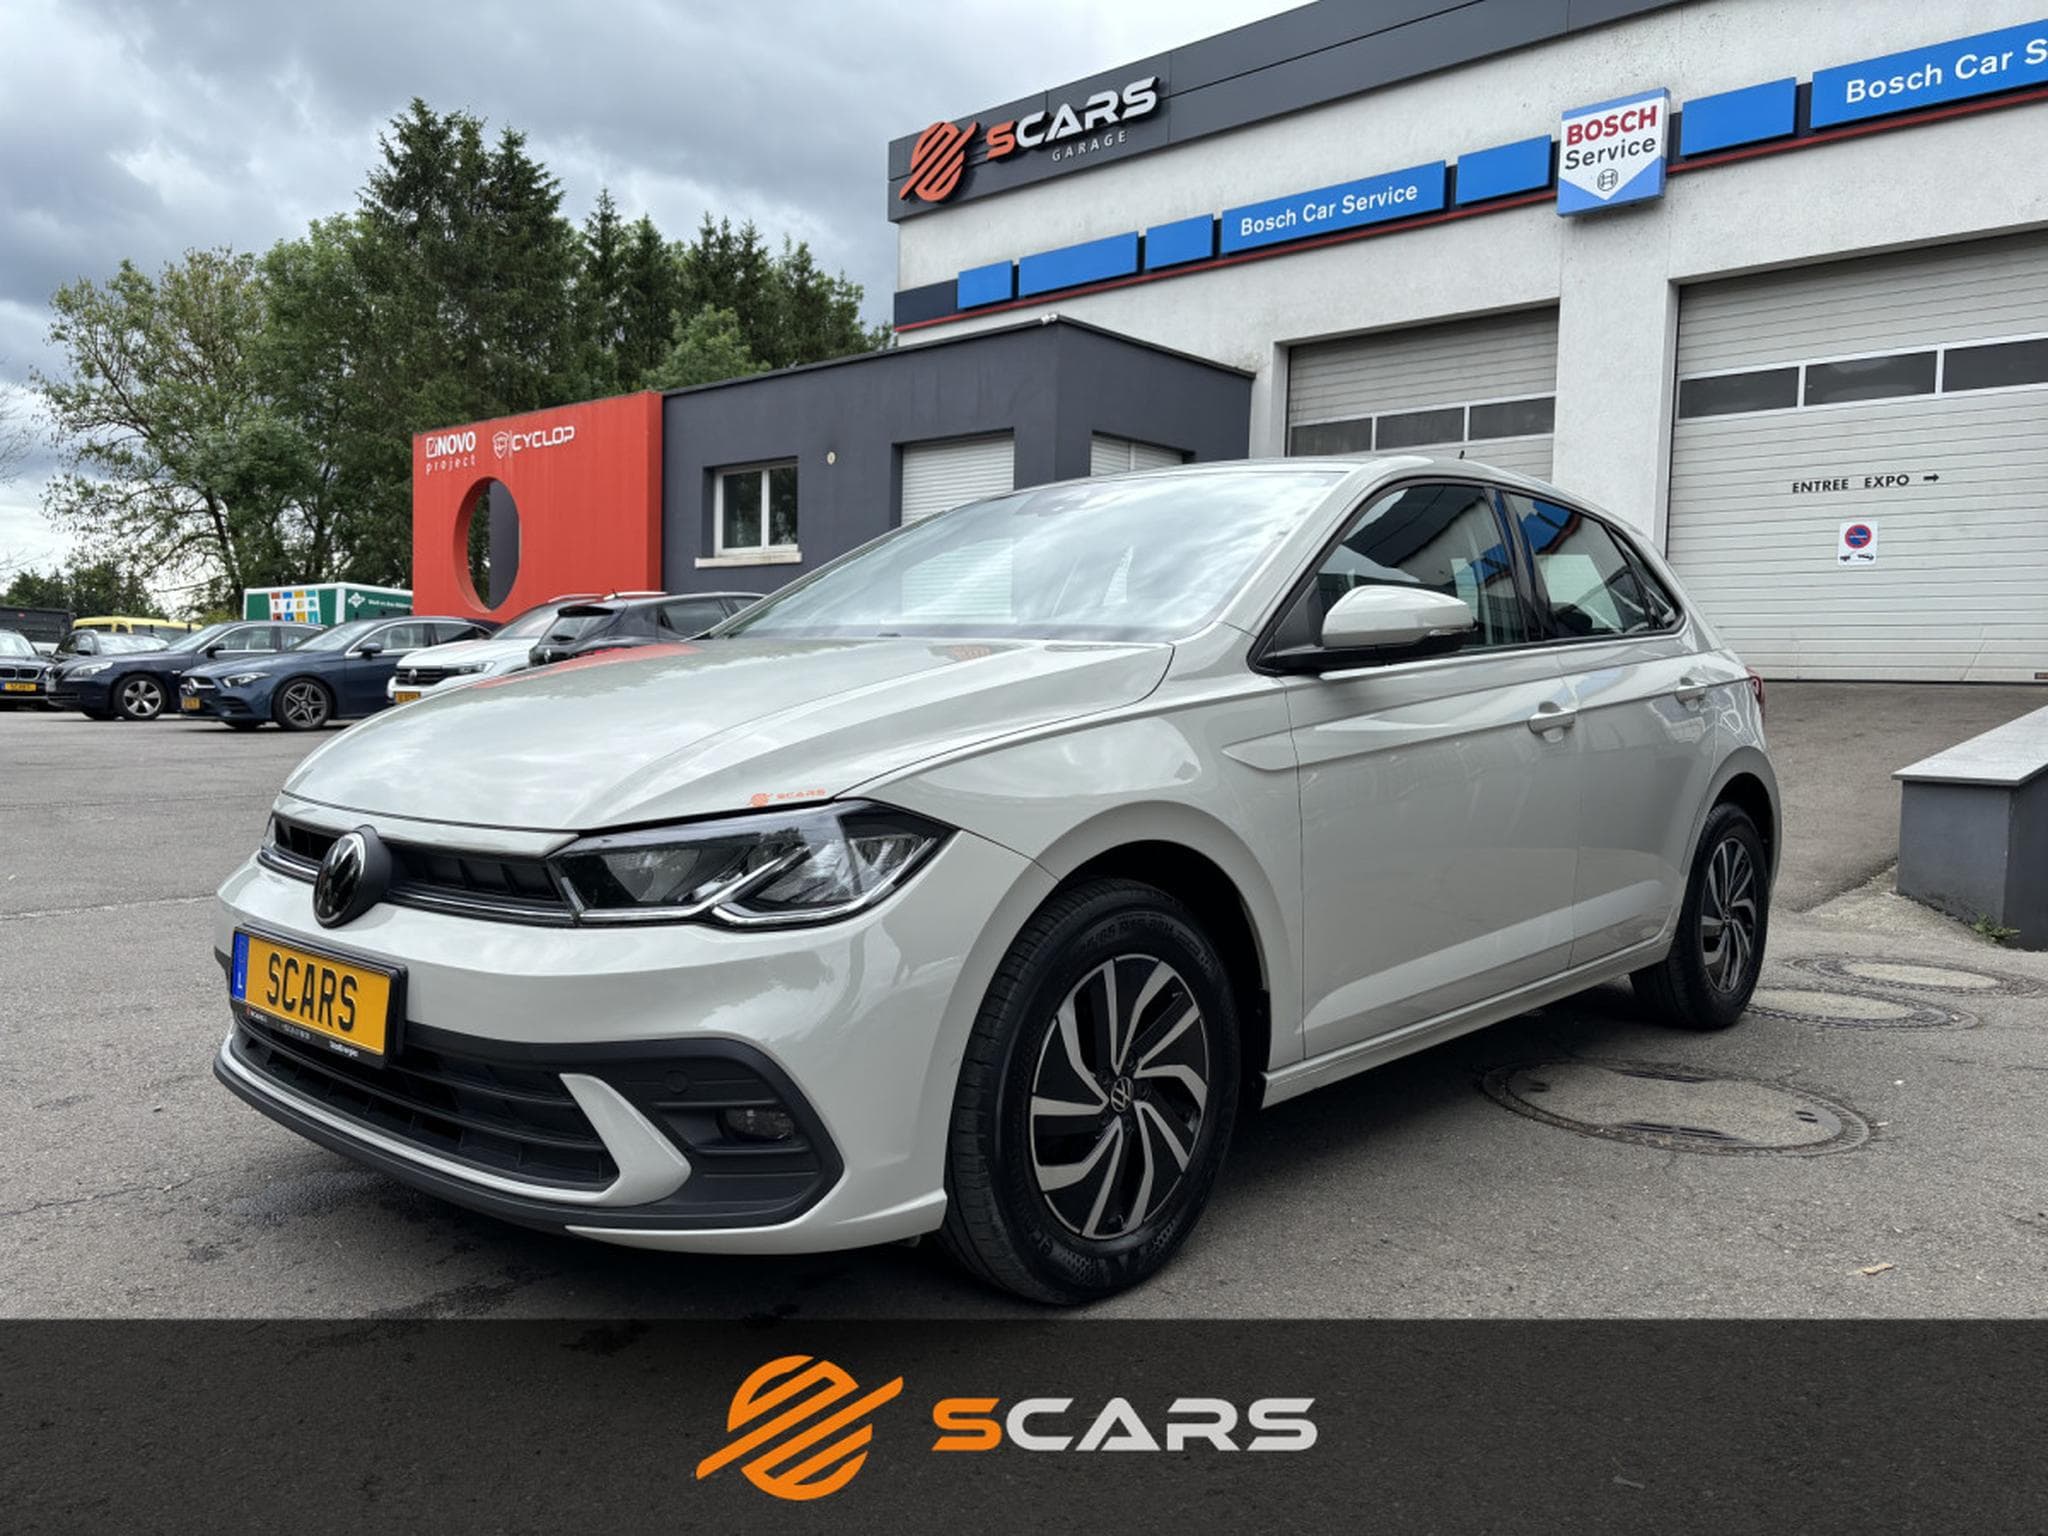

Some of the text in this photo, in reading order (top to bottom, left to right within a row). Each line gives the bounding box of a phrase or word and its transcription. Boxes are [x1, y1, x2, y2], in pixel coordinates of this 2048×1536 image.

[1846, 64, 1943, 103] Bosch
[1955, 51, 2014, 79] Car
[986, 76, 1158, 160] SCARS
[1566, 104, 1658, 147] BOSCH
[1052, 130, 1127, 162] GARAGE
[1565, 137, 1656, 170] Service
[1240, 184, 1418, 237] Bosch Car Service
[425, 455, 476, 476] project
[1792, 474, 1910, 493] ENTREE EXPO
[266, 951, 358, 1032] SCARS
